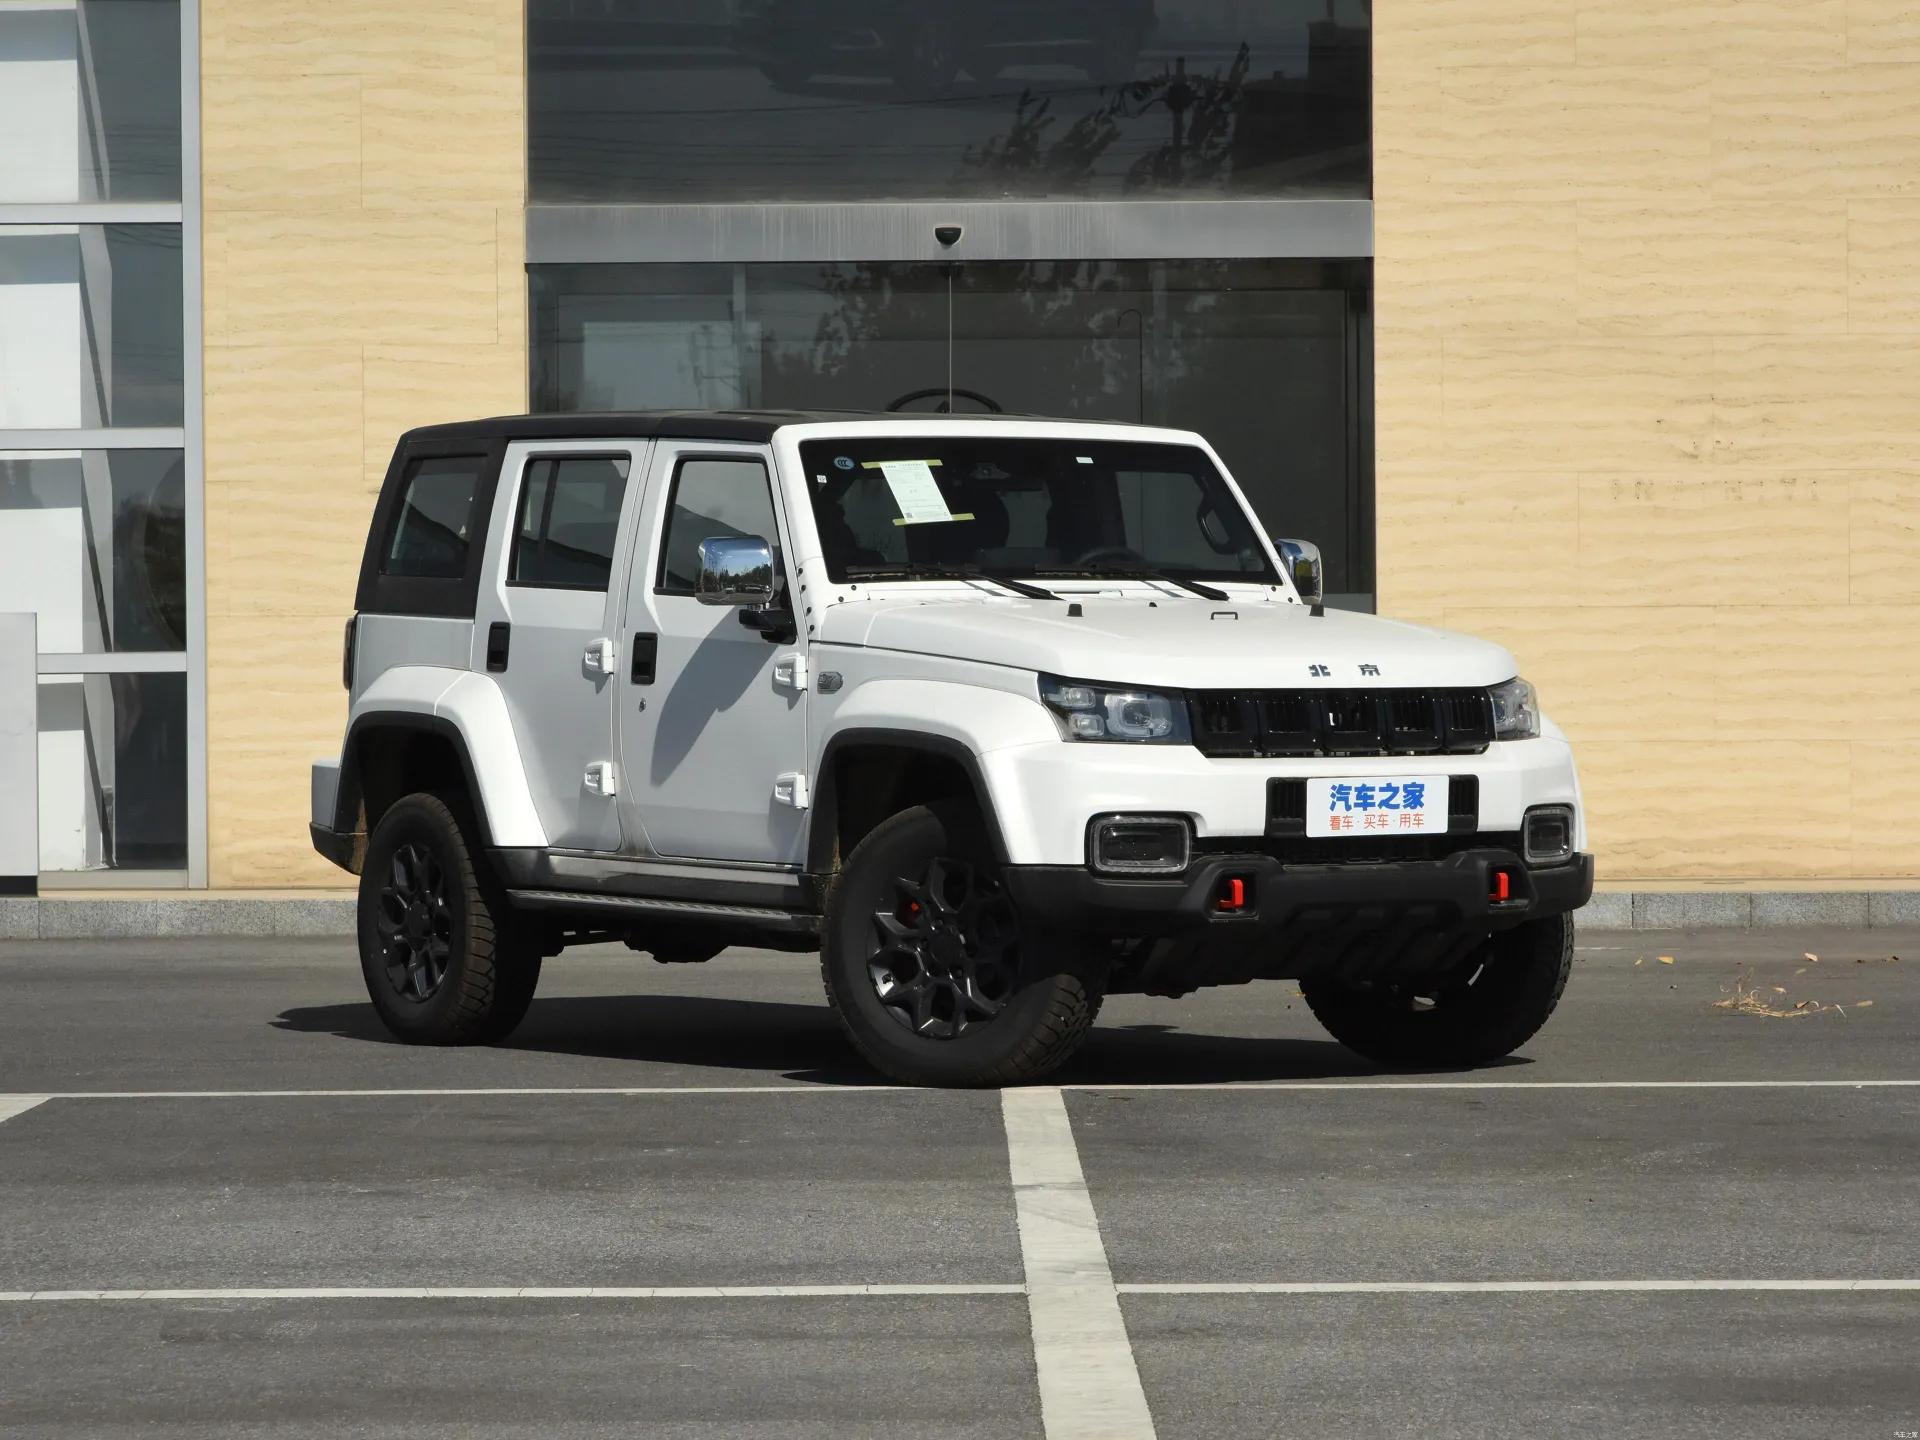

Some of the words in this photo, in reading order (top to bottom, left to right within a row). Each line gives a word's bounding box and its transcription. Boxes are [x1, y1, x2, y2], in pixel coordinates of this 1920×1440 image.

[1308, 664, 1381, 677] 北京
[1329, 782, 1425, 812] 汽车之家
